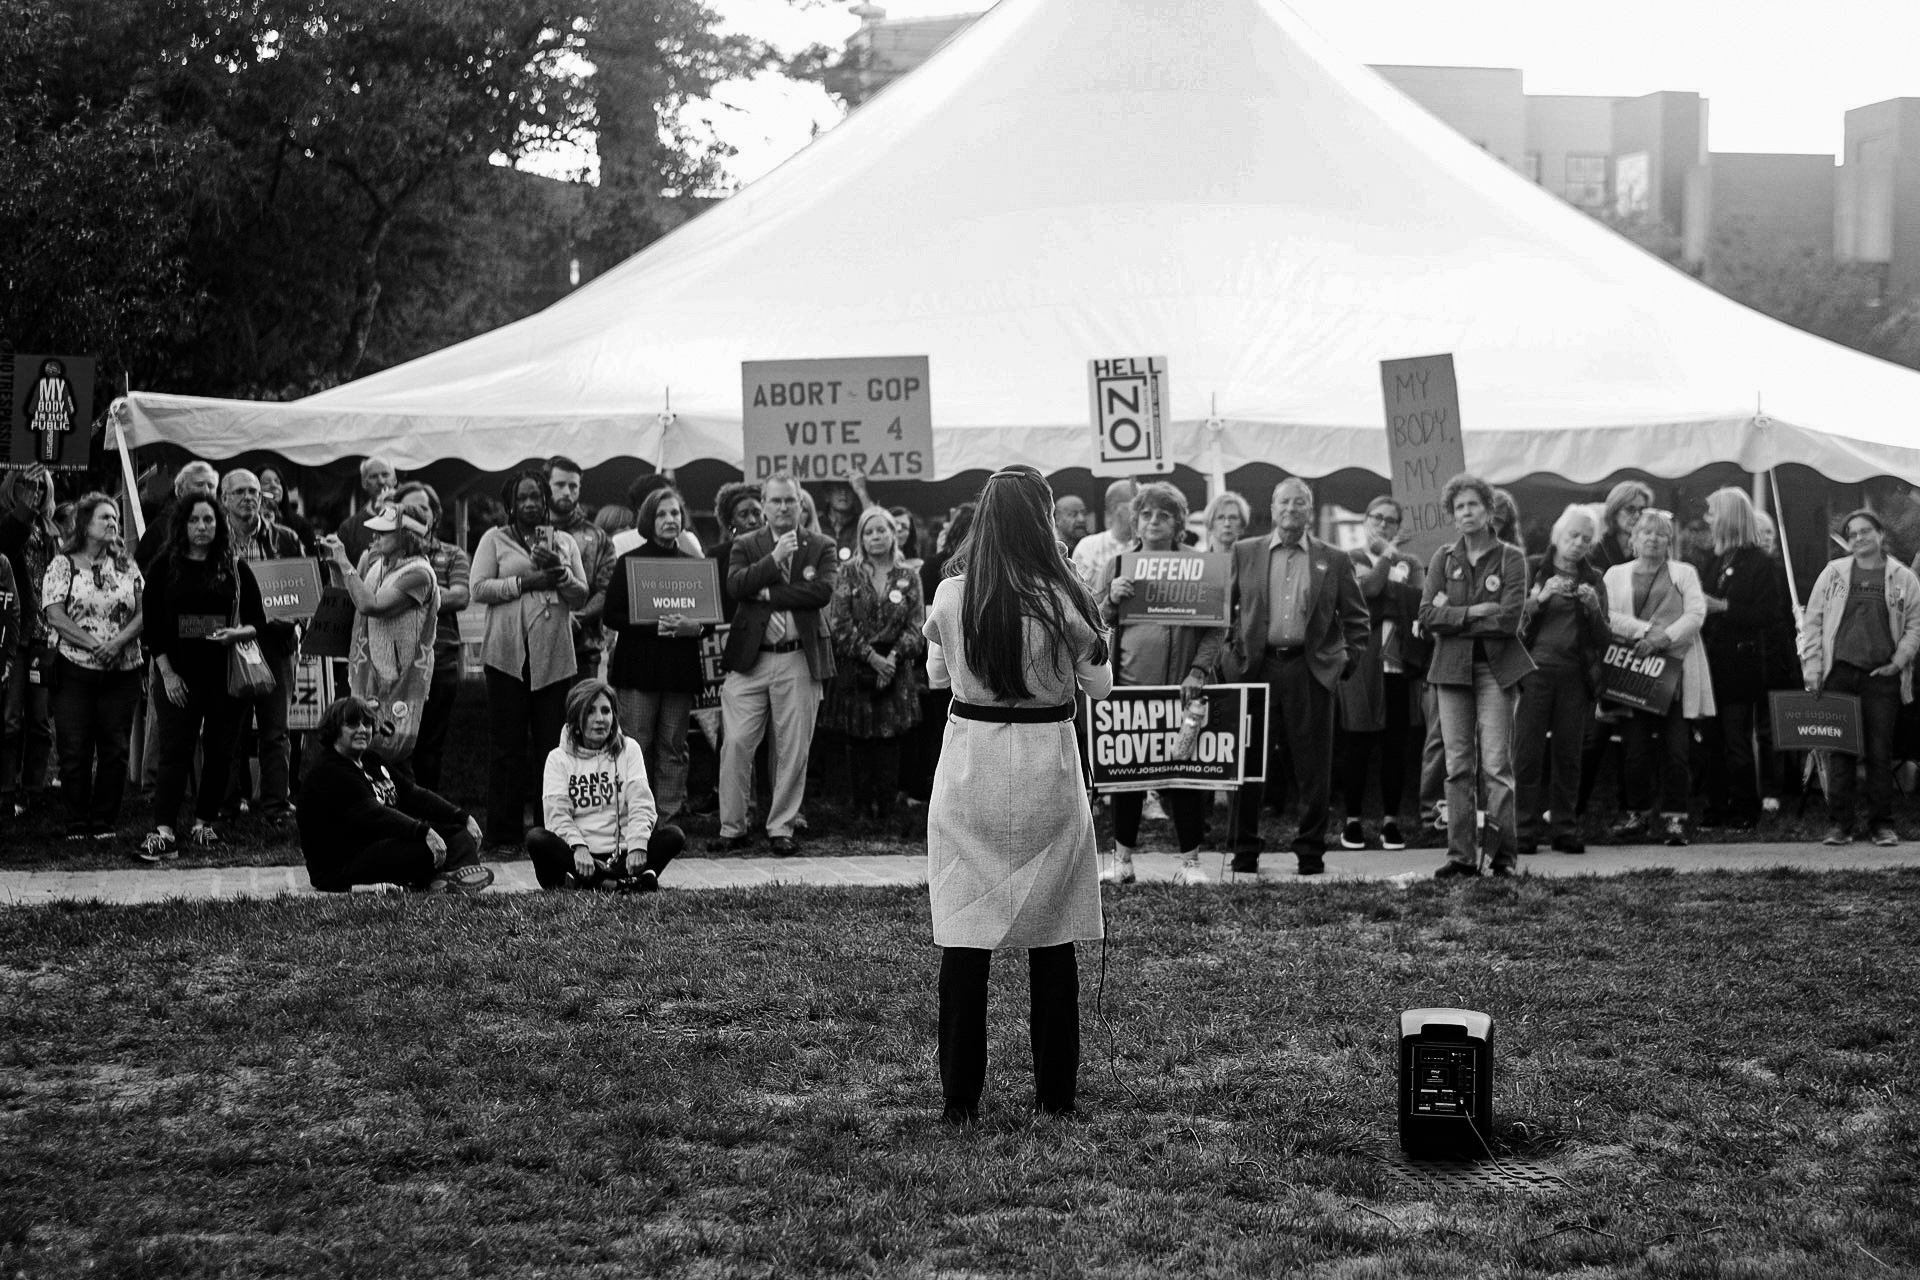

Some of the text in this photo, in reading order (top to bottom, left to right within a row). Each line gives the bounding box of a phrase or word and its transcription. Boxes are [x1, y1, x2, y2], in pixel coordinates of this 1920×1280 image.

[1094, 357, 1162, 377] HELL
[40, 377, 66, 400] MY
[753, 377, 920, 408] ABORT GOP
[1396, 368, 1431, 403] MY
[38, 400, 65, 412] BODY
[31, 420, 70, 431] PUBLIC
[785, 416, 903, 446] VOTE 4
[756, 451, 922, 480] DEMOCRATS
[1404, 456, 1438, 491] MY
[1134, 558, 1205, 580] DEFEND
[660, 578, 704, 592] support
[1145, 581, 1208, 602] CHOICE
[261, 594, 299, 608] OMEN
[652, 597, 696, 608] WOMEN
[1603, 644, 1666, 678] DEFEND
[1797, 725, 1843, 738] WOMEN
[1097, 731, 1234, 766] GOVEROR
[569, 771, 609, 786] BANS
[1108, 765, 1223, 776] WWW.JOSHSHAPIRO.ORG
[568, 781, 624, 798] OFF MY
[571, 794, 613, 809] BODY
